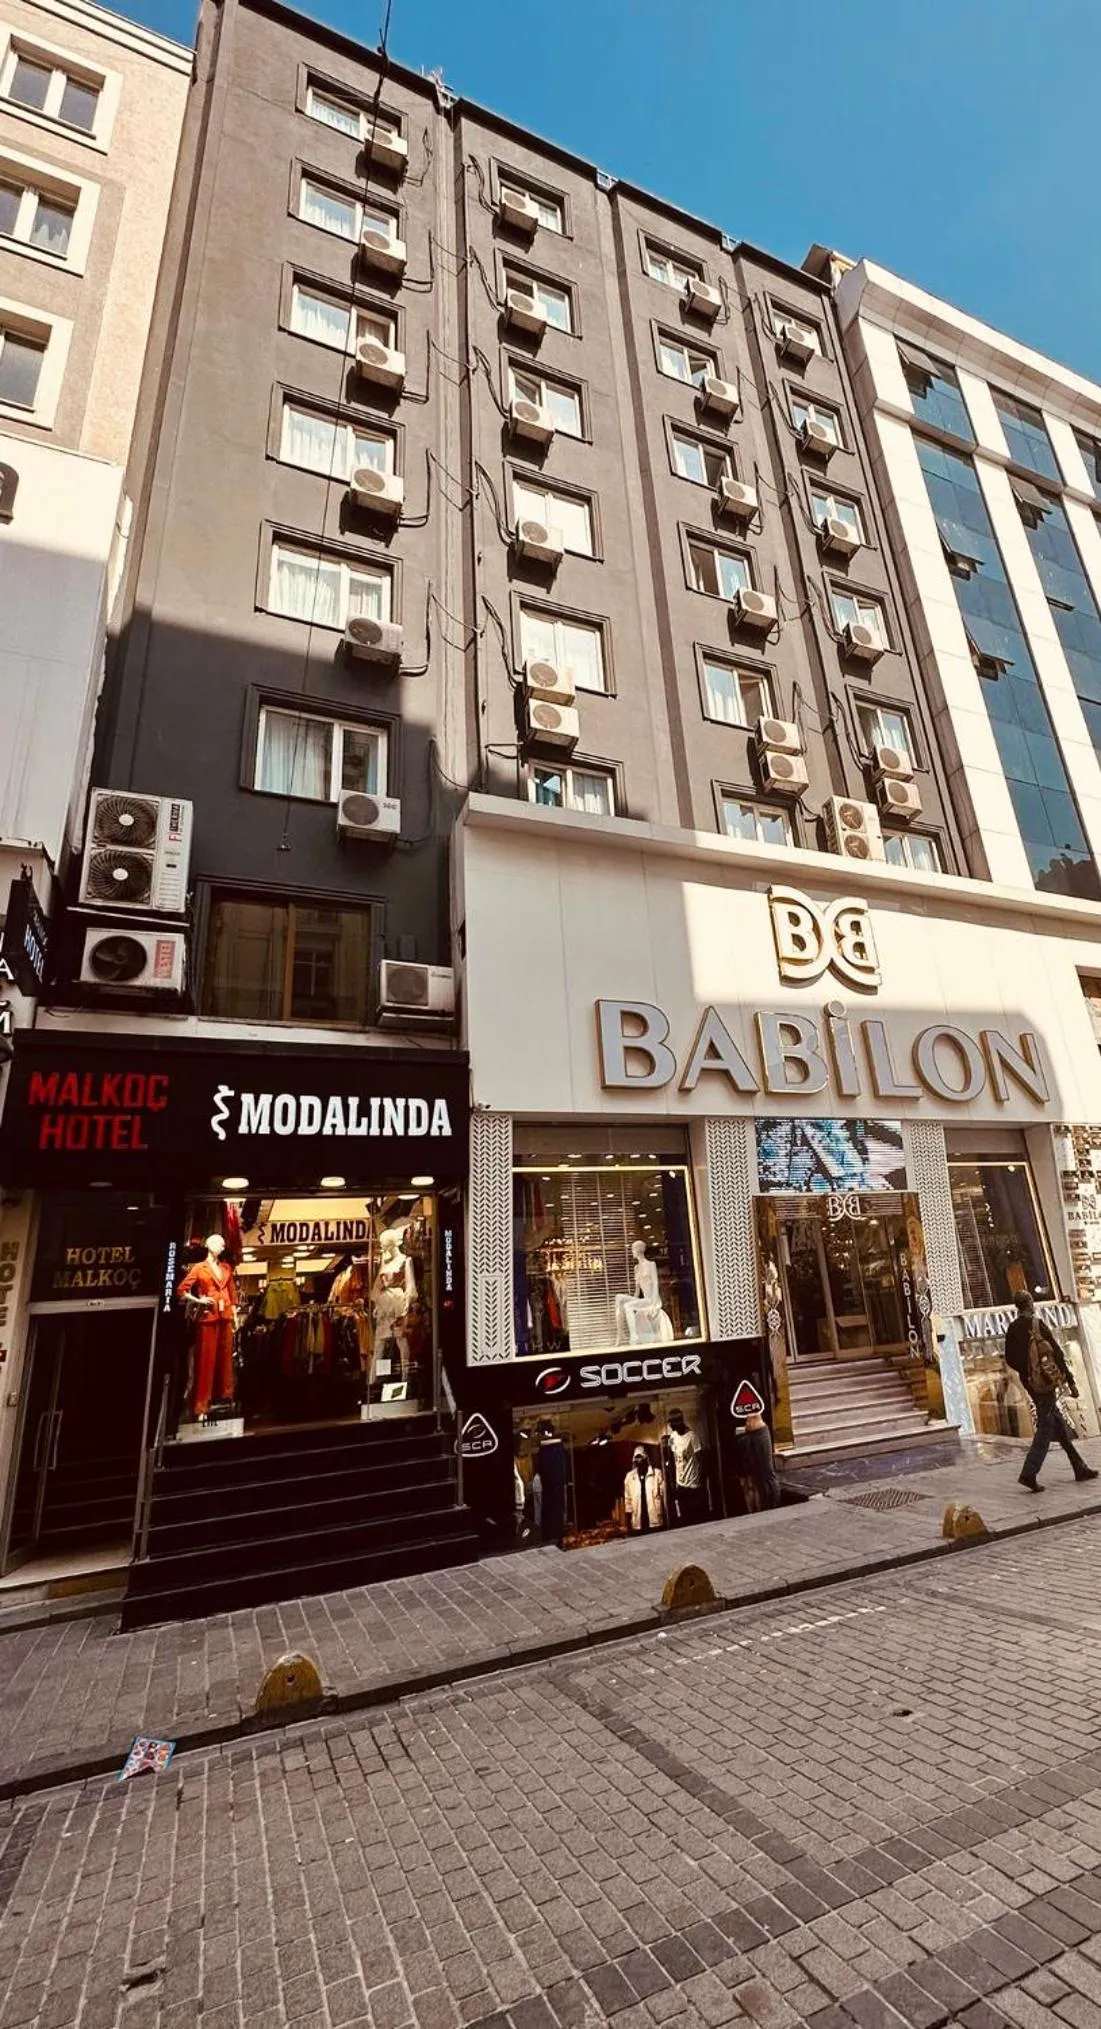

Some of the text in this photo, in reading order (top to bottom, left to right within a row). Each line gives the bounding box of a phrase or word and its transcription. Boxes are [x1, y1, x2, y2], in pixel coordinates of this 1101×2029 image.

[595, 1000, 1050, 1104] BABİLON
[28, 1072, 170, 1112] MALKOÇ
[38, 1114, 149, 1150] HOTEL
[238, 1093, 452, 1136] MODALINDA
[65, 1246, 136, 1266] HOTEL
[444, 1230, 453, 1291] MODALINDA
[52, 1268, 142, 1290] MALKOÇ
[163, 1242, 177, 1312] ROSEMARIA
[580, 1355, 702, 1388] SOCCER
